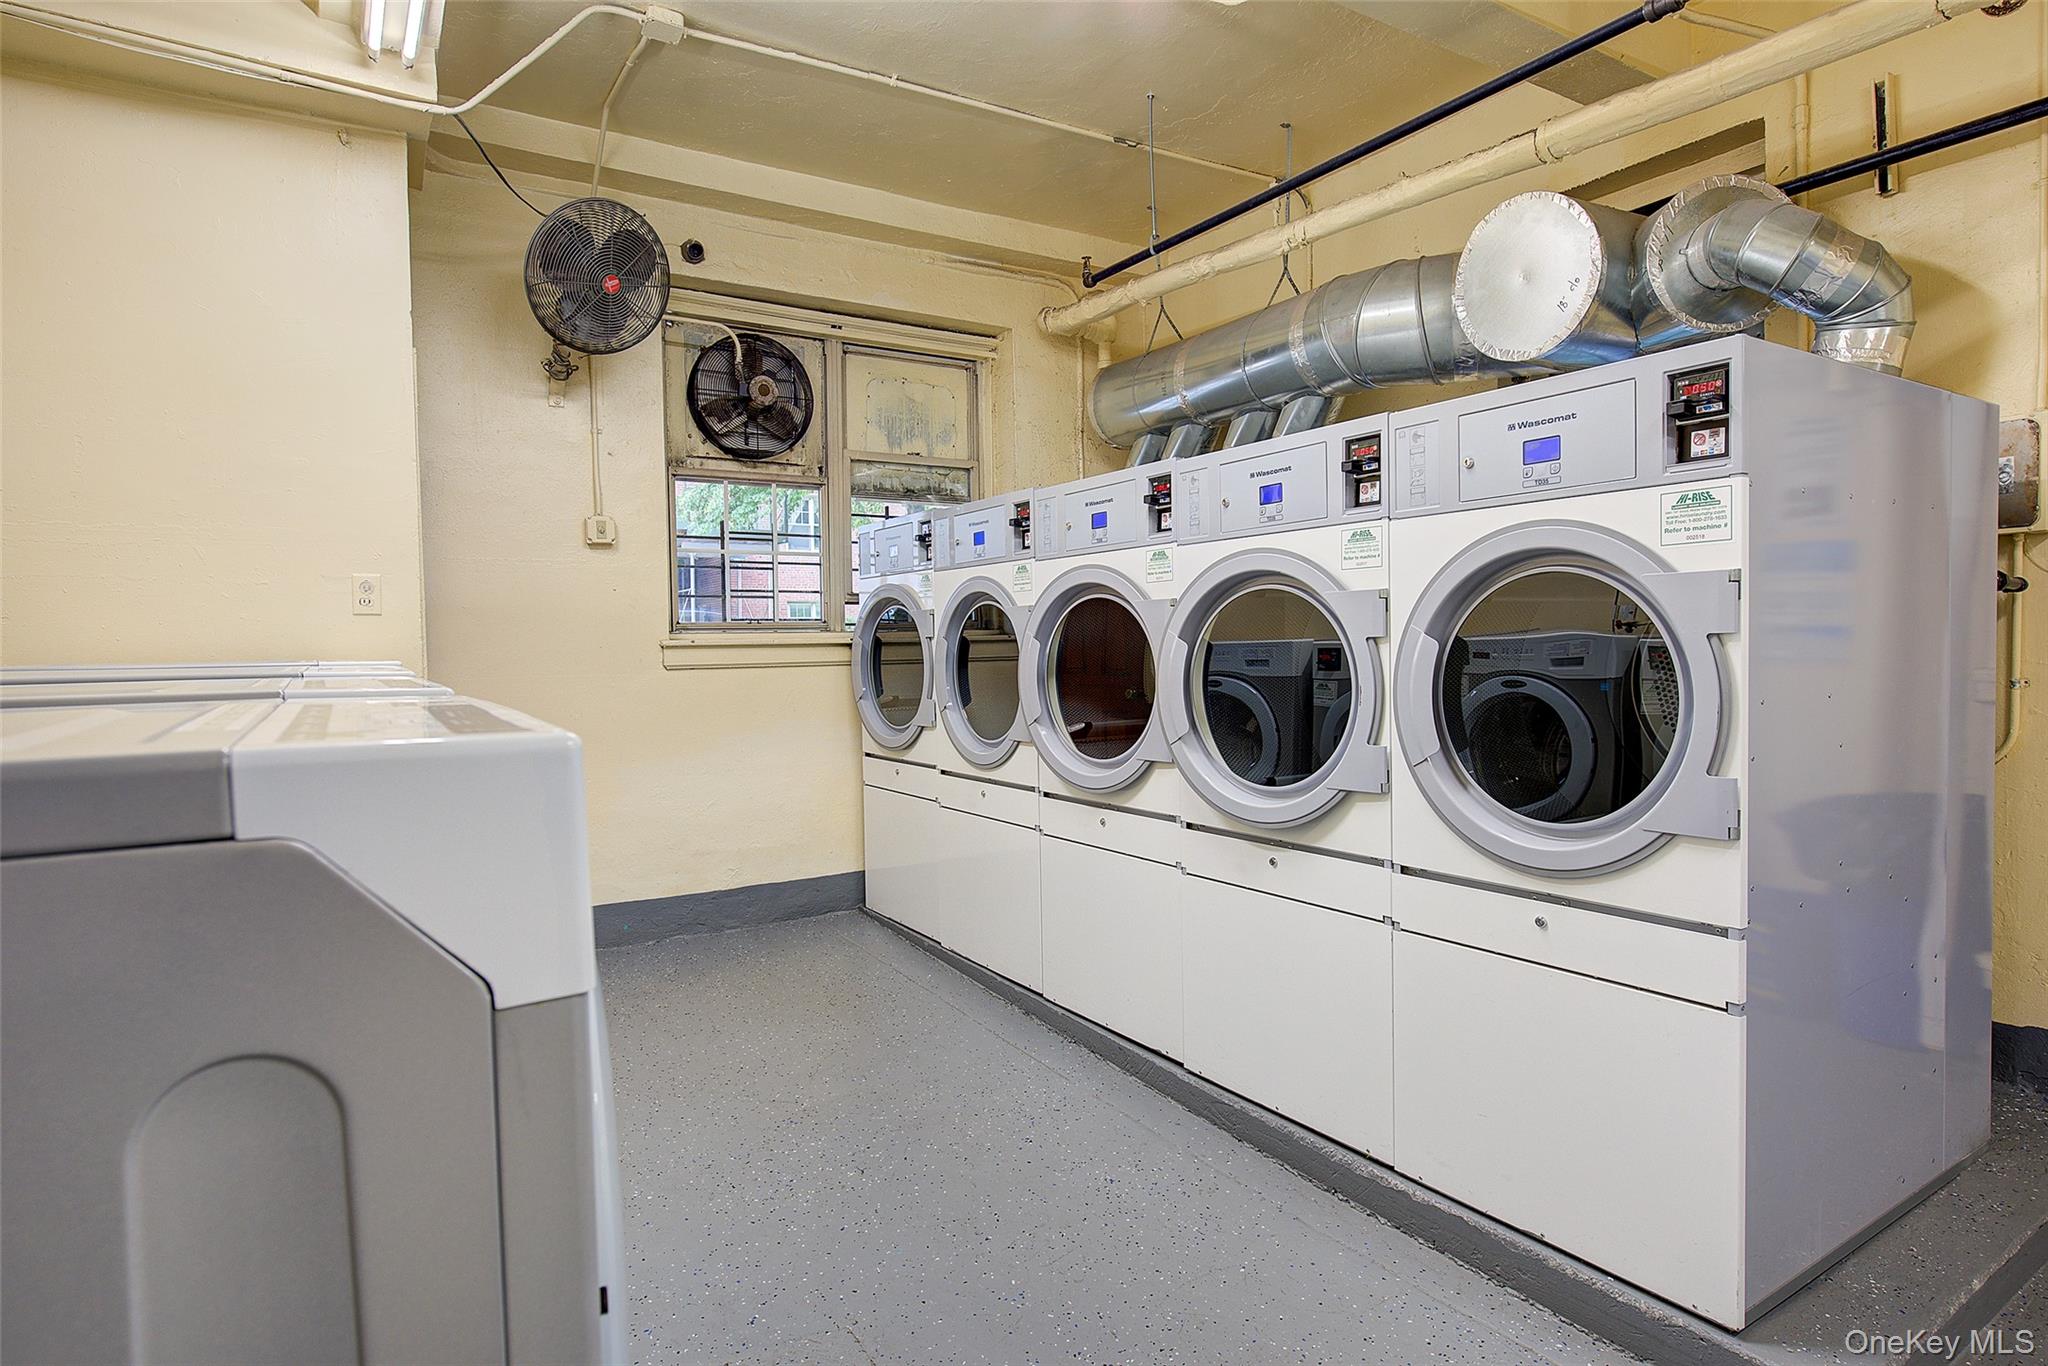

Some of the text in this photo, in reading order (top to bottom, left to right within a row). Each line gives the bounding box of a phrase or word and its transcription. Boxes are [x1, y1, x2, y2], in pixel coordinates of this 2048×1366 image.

[1517, 412, 1578, 430] Wascomat
[1256, 465, 1292, 478] Wascomat
[1676, 491, 1716, 504] HI-RISE
[1692, 523, 1722, 531] machine
